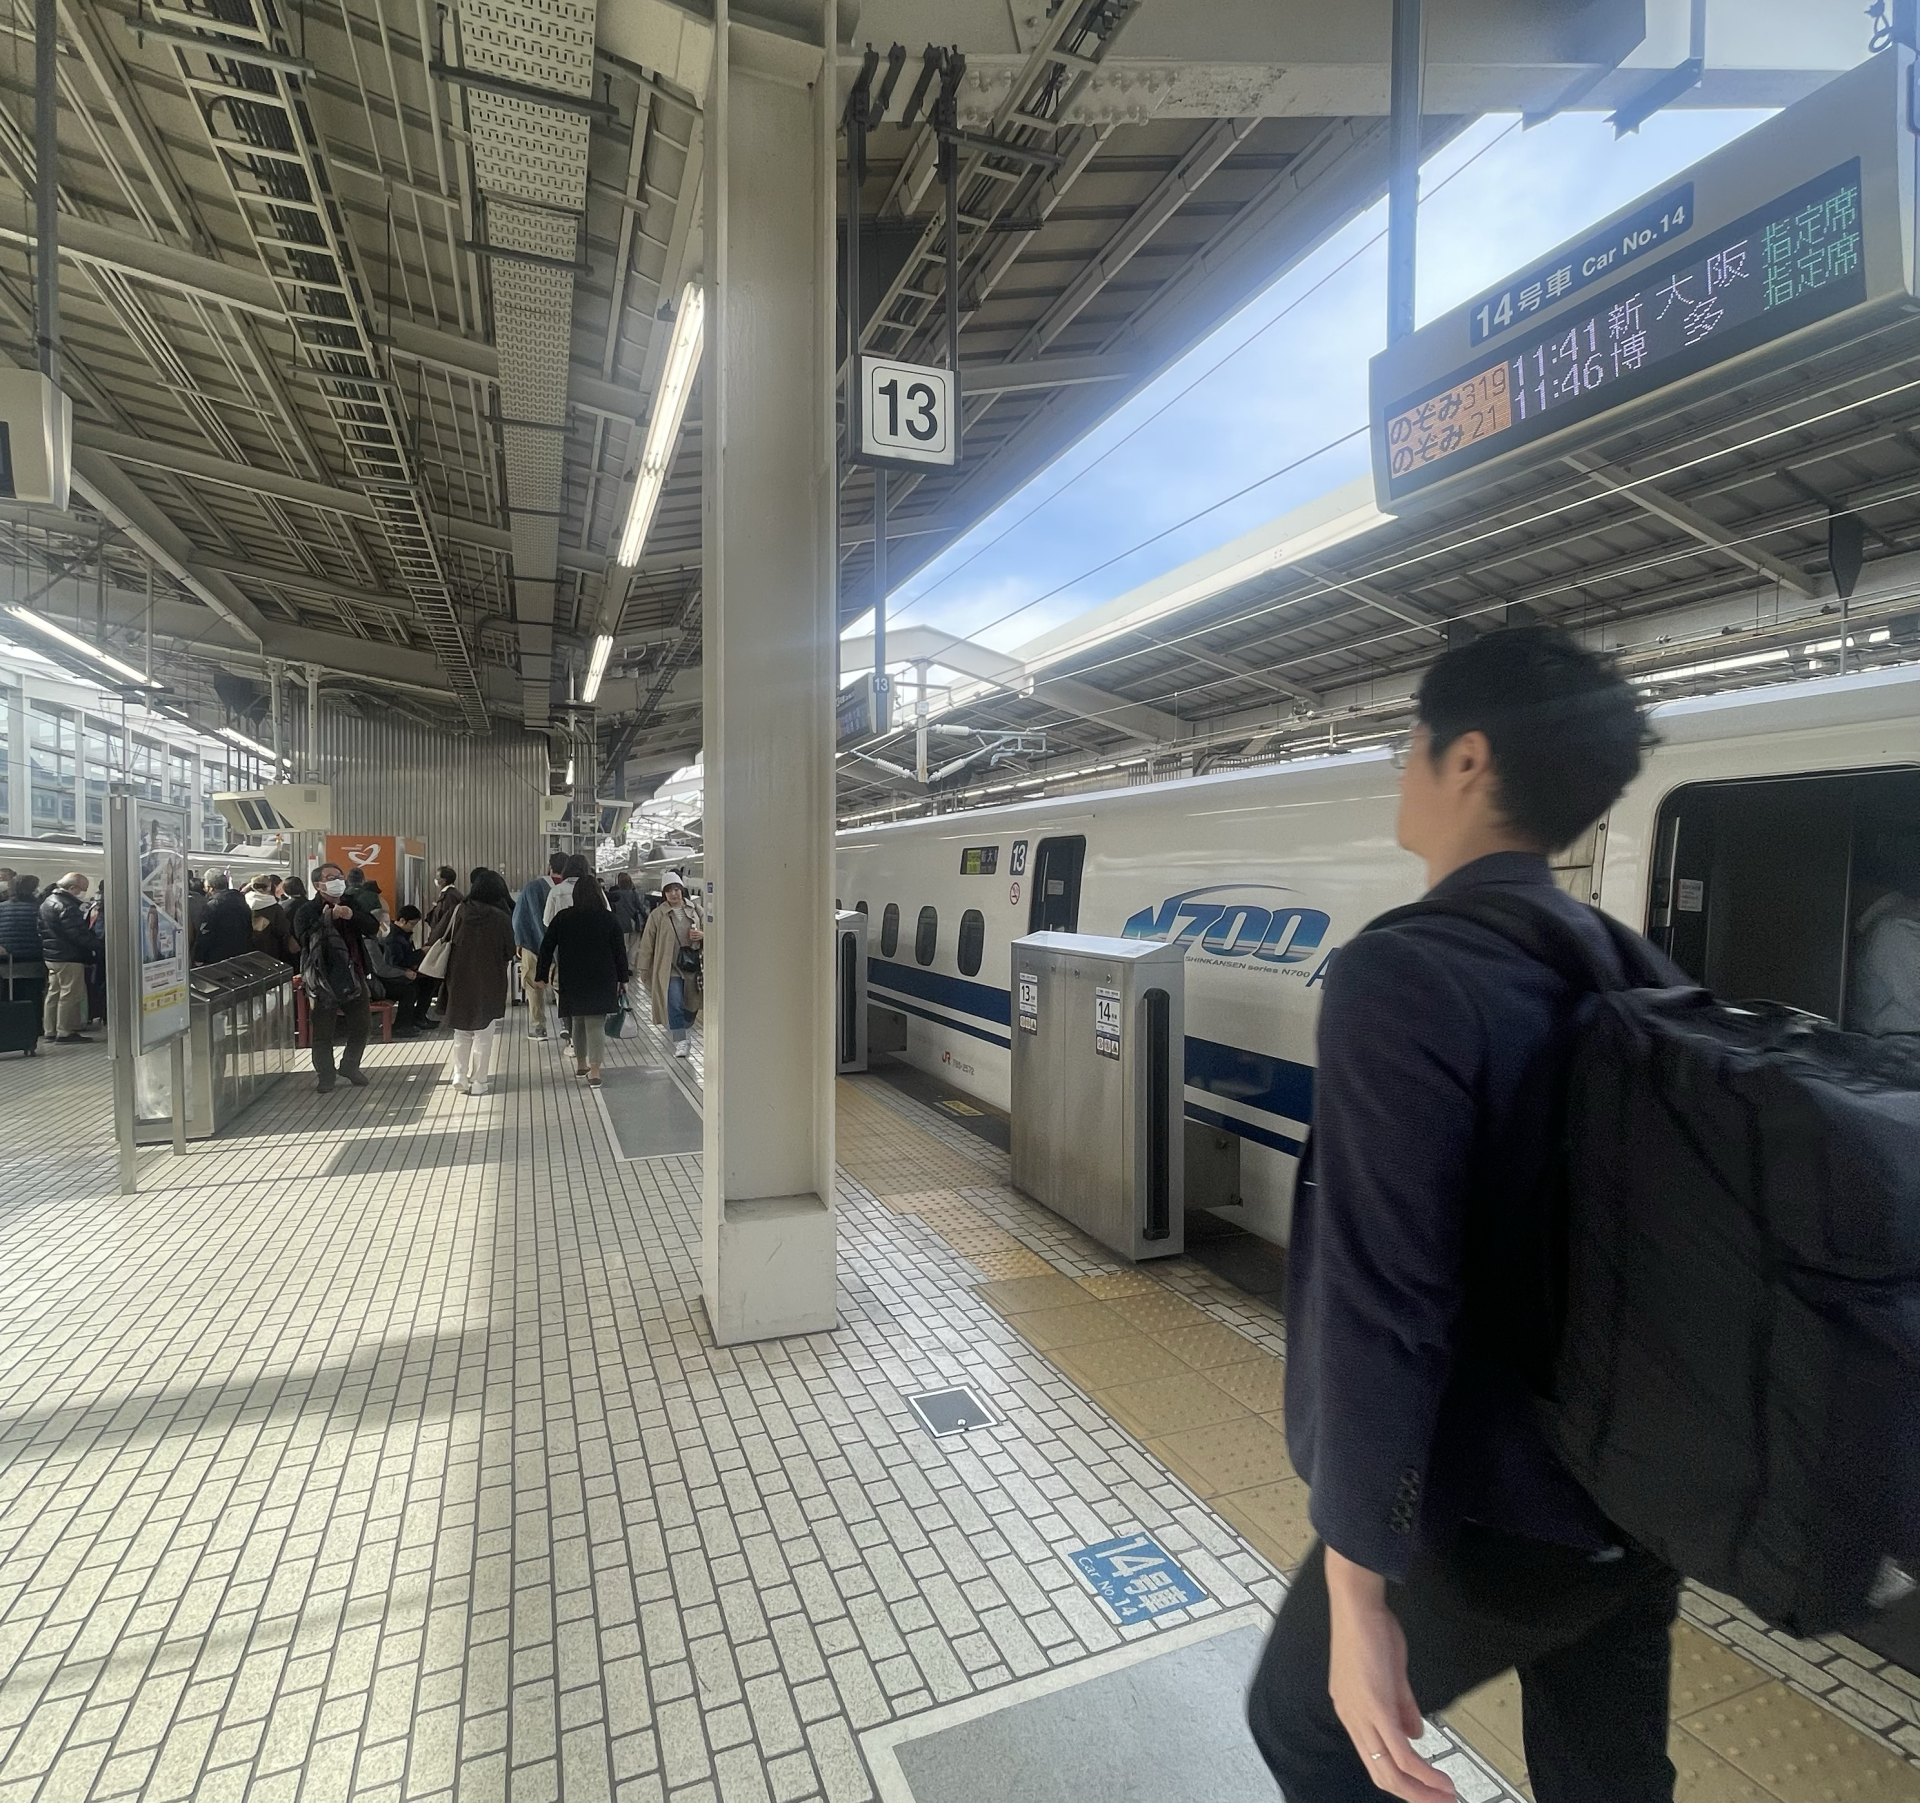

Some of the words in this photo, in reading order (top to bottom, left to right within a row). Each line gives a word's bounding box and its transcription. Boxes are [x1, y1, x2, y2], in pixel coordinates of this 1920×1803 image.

[1476, 264, 1573, 338] 14号車
[1582, 247, 1617, 277] Car
[1512, 317, 1597, 387] 11:41
[1761, 186, 1858, 269] 指定席
[1514, 352, 1604, 420] 11:46
[1763, 232, 1860, 311] 指定席
[878, 378, 938, 441] 13
[874, 677, 889, 691] 13
[1012, 844, 1026, 872] 13
[1121, 886, 1330, 963] N700
[1185, 955, 1247, 969] SHINKANSEN
[1248, 964, 1278, 974] series
[1281, 968, 1310, 978] N700
[942, 1050, 951, 1065] JR
[1078, 1556, 1101, 1578] Car
[1094, 1536, 1189, 1613] 14号車
